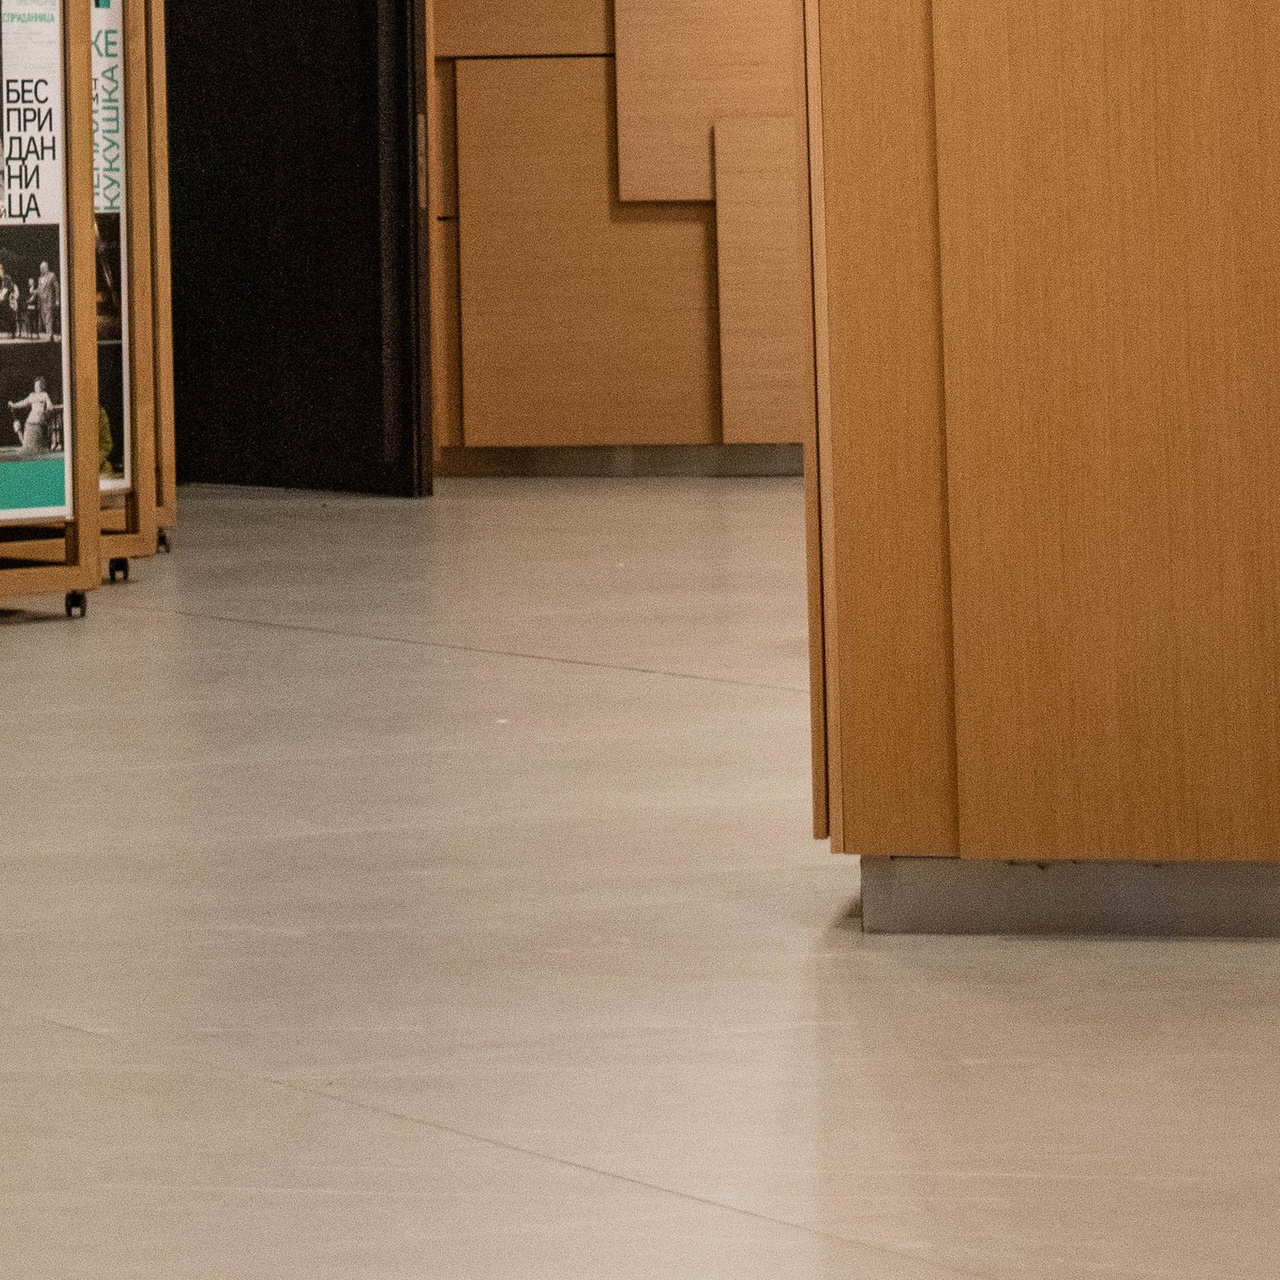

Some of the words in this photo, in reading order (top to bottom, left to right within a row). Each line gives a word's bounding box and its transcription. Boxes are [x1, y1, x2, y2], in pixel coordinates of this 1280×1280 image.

[6, 78, 49, 105] БЕС
[6, 107, 53, 132] ПРИ
[5, 136, 56, 167] ДАН
[101, 63, 121, 211] КУКУШКА
[7, 164, 40, 190] НИ
[8, 192, 41, 223] ЦА
